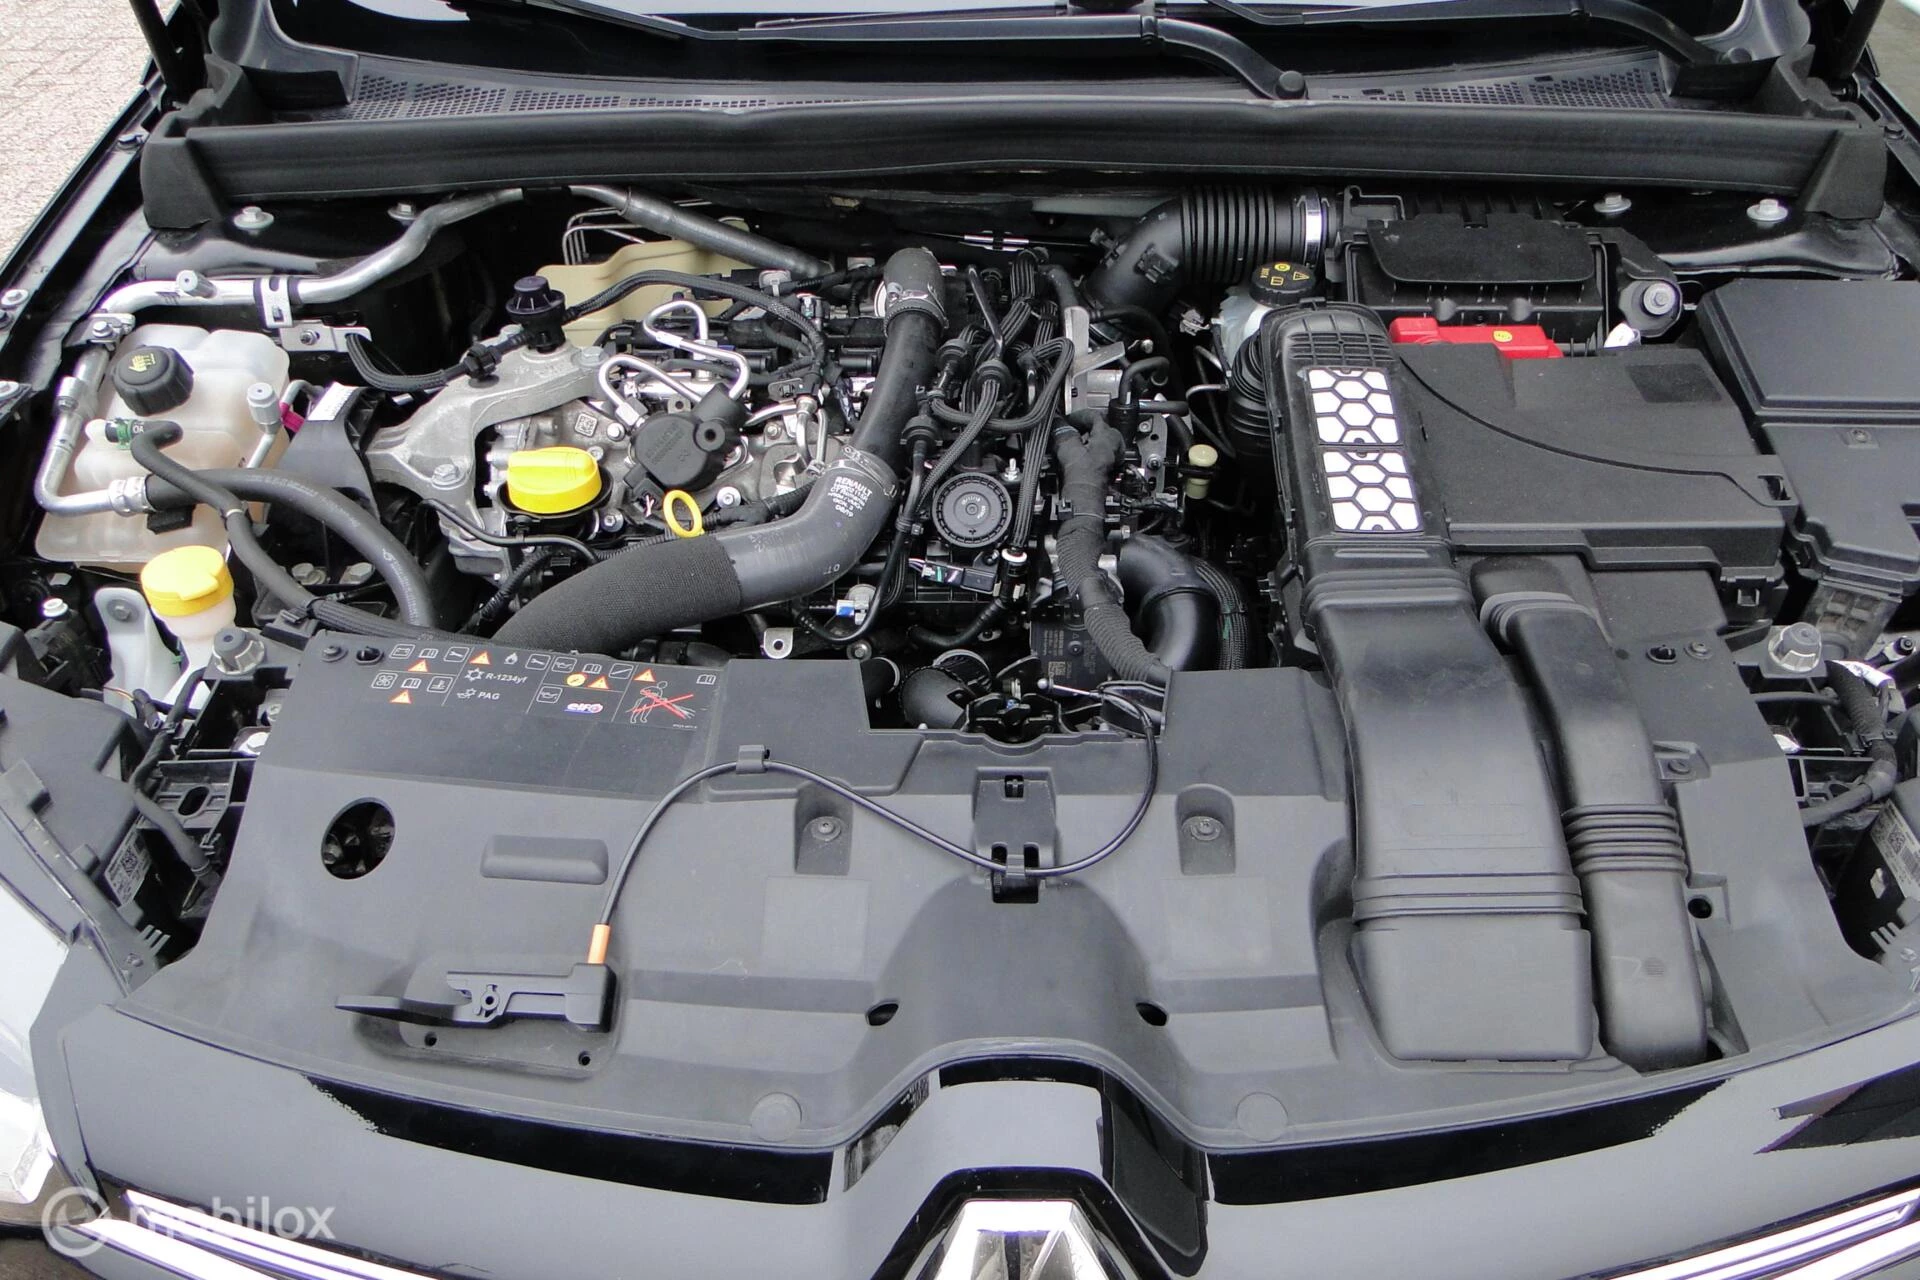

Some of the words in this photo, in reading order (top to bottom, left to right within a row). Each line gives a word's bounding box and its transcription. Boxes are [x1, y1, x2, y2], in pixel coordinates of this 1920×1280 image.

[835, 476, 872, 497] RENAULT
[485, 673, 529, 684] R-1234yf
[478, 691, 501, 701] PAG
